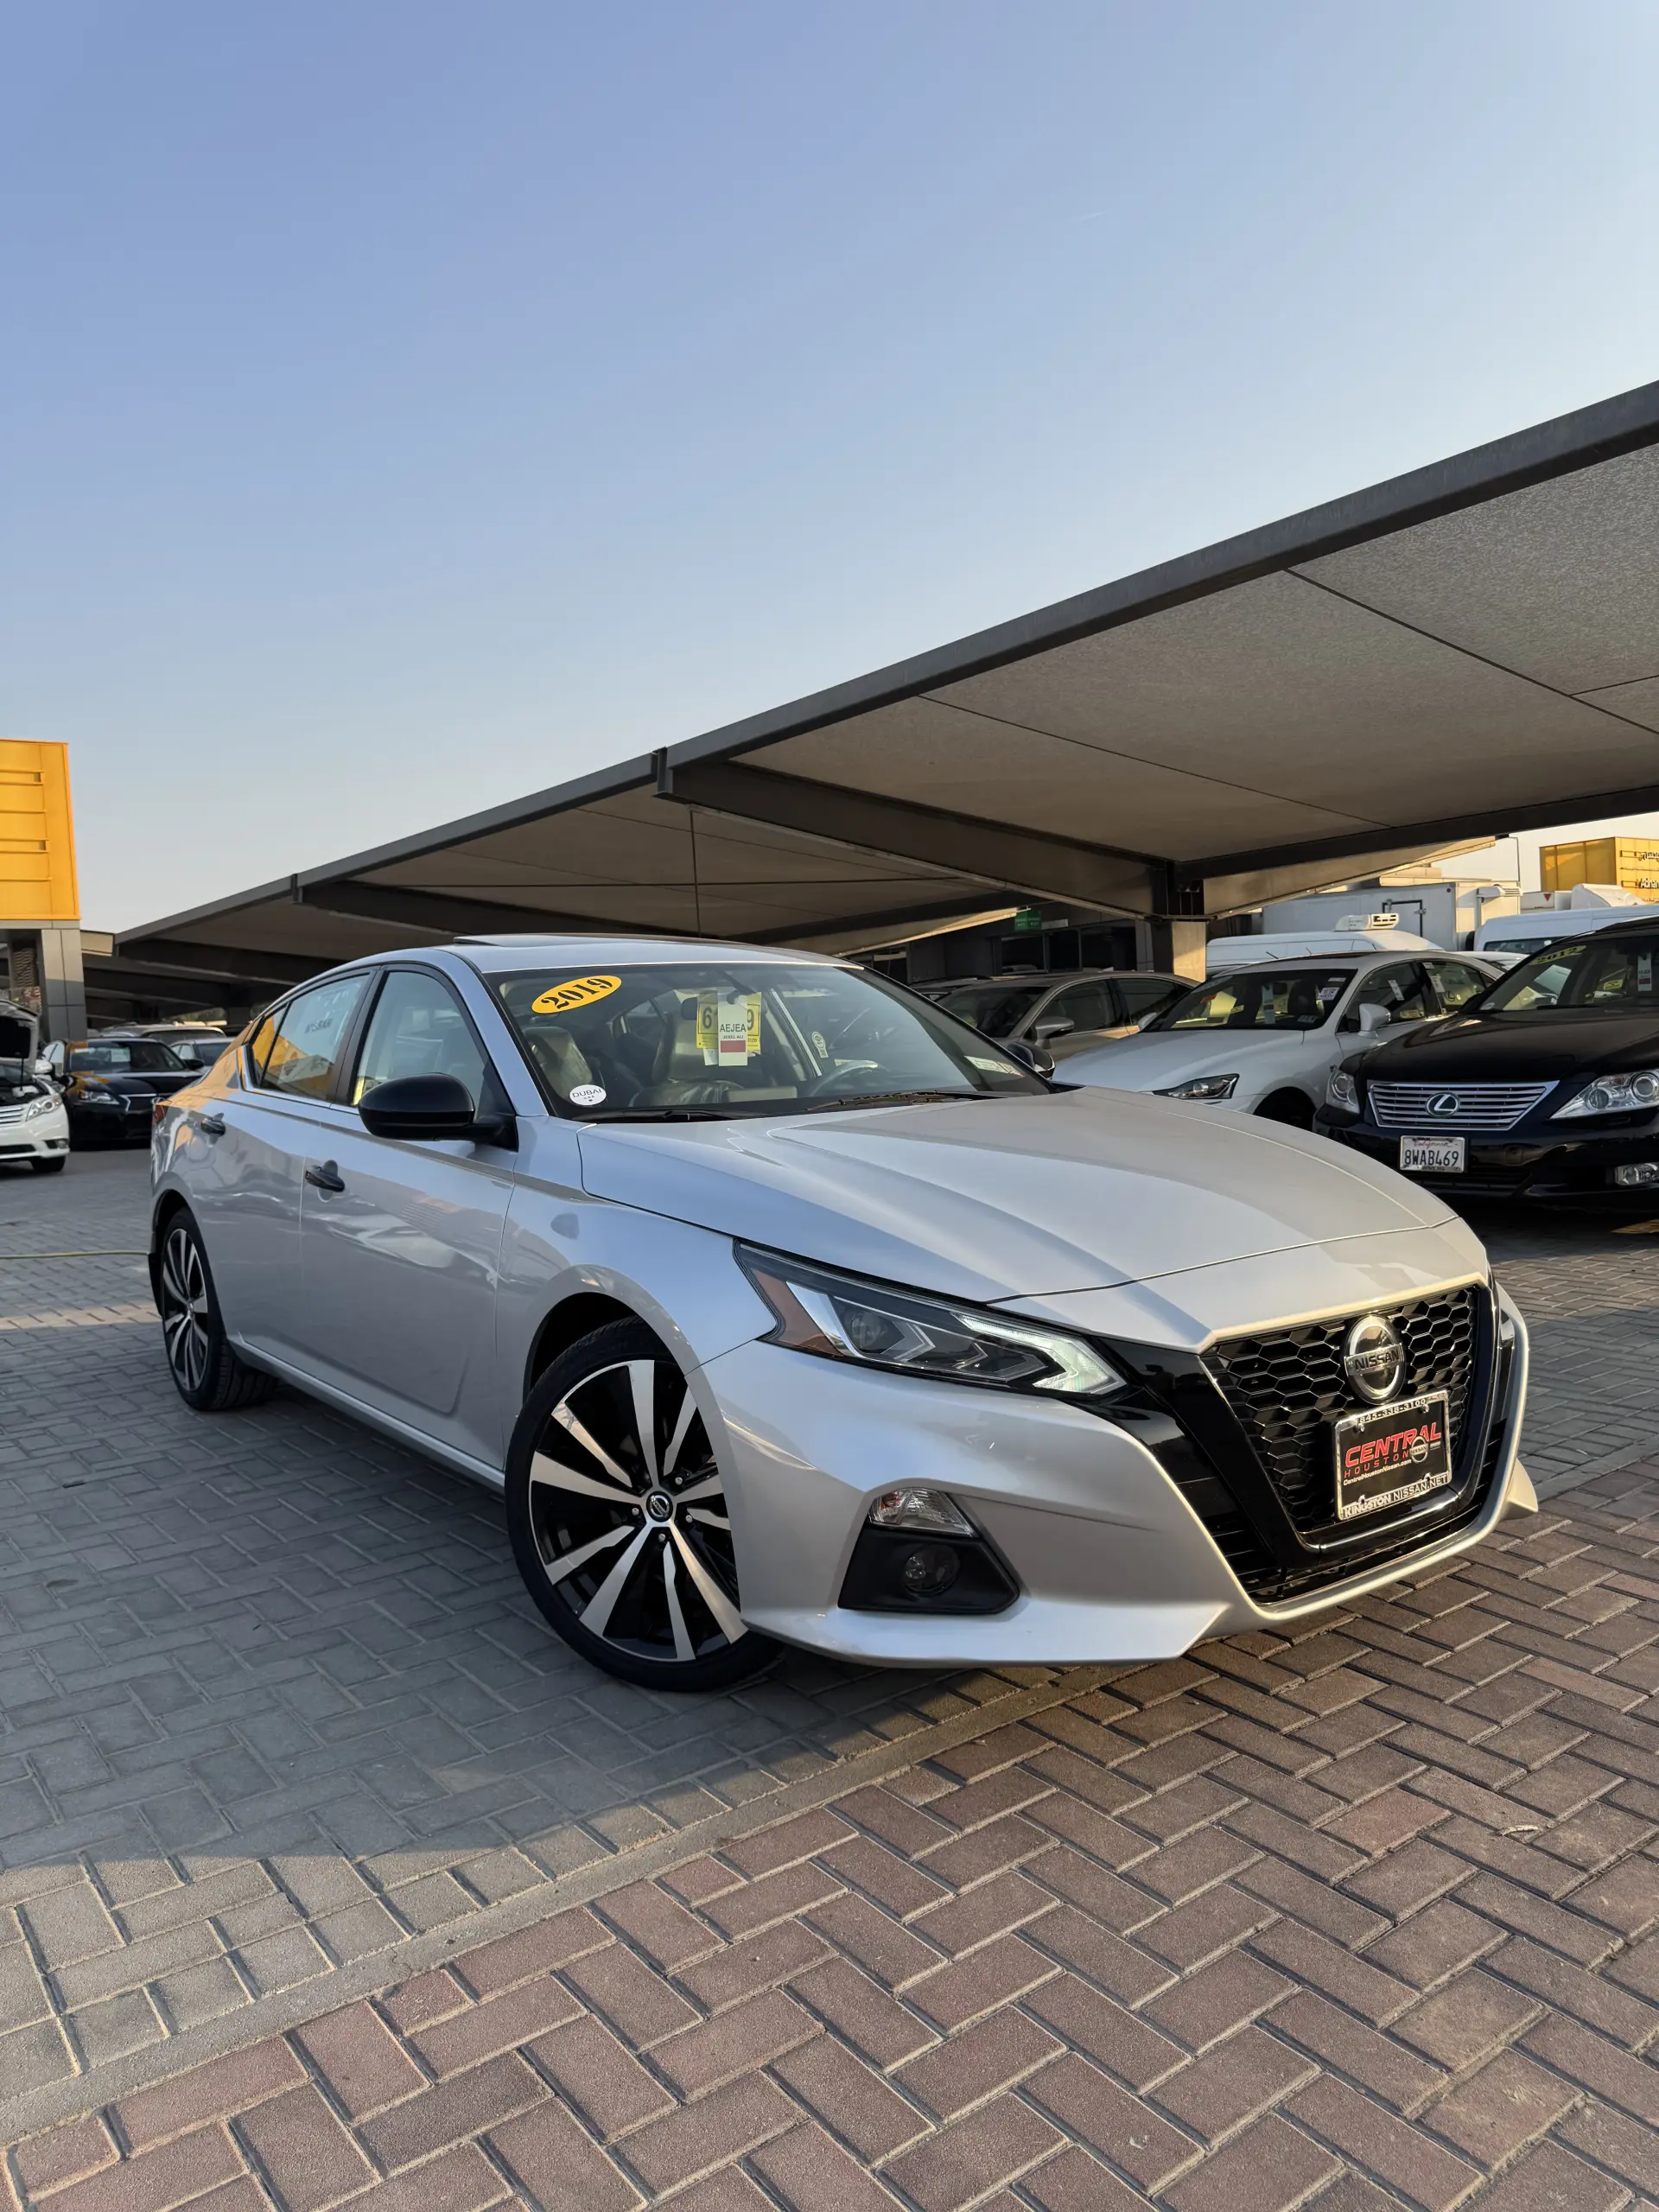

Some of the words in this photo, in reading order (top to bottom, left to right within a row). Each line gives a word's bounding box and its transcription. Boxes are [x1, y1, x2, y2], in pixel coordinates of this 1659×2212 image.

[541, 978, 613, 1009] 2019
[719, 1023, 747, 1033] AEJEA
[572, 1088, 602, 1098] DUBAI
[1403, 1148, 1459, 1167] 8WAB469
[1354, 1349, 1400, 1370] NISSAN
[1358, 1398, 1427, 1424] 845-338-3100
[1344, 1421, 1442, 1468] CENTRAL
[1343, 1449, 1409, 1479] HOUSTON
[1343, 1459, 1412, 1486] CentralHoustonNissan.com
[1344, 1494, 1392, 1517] KINGSTON
[1393, 1473, 1447, 1503] NISSAN.NET
